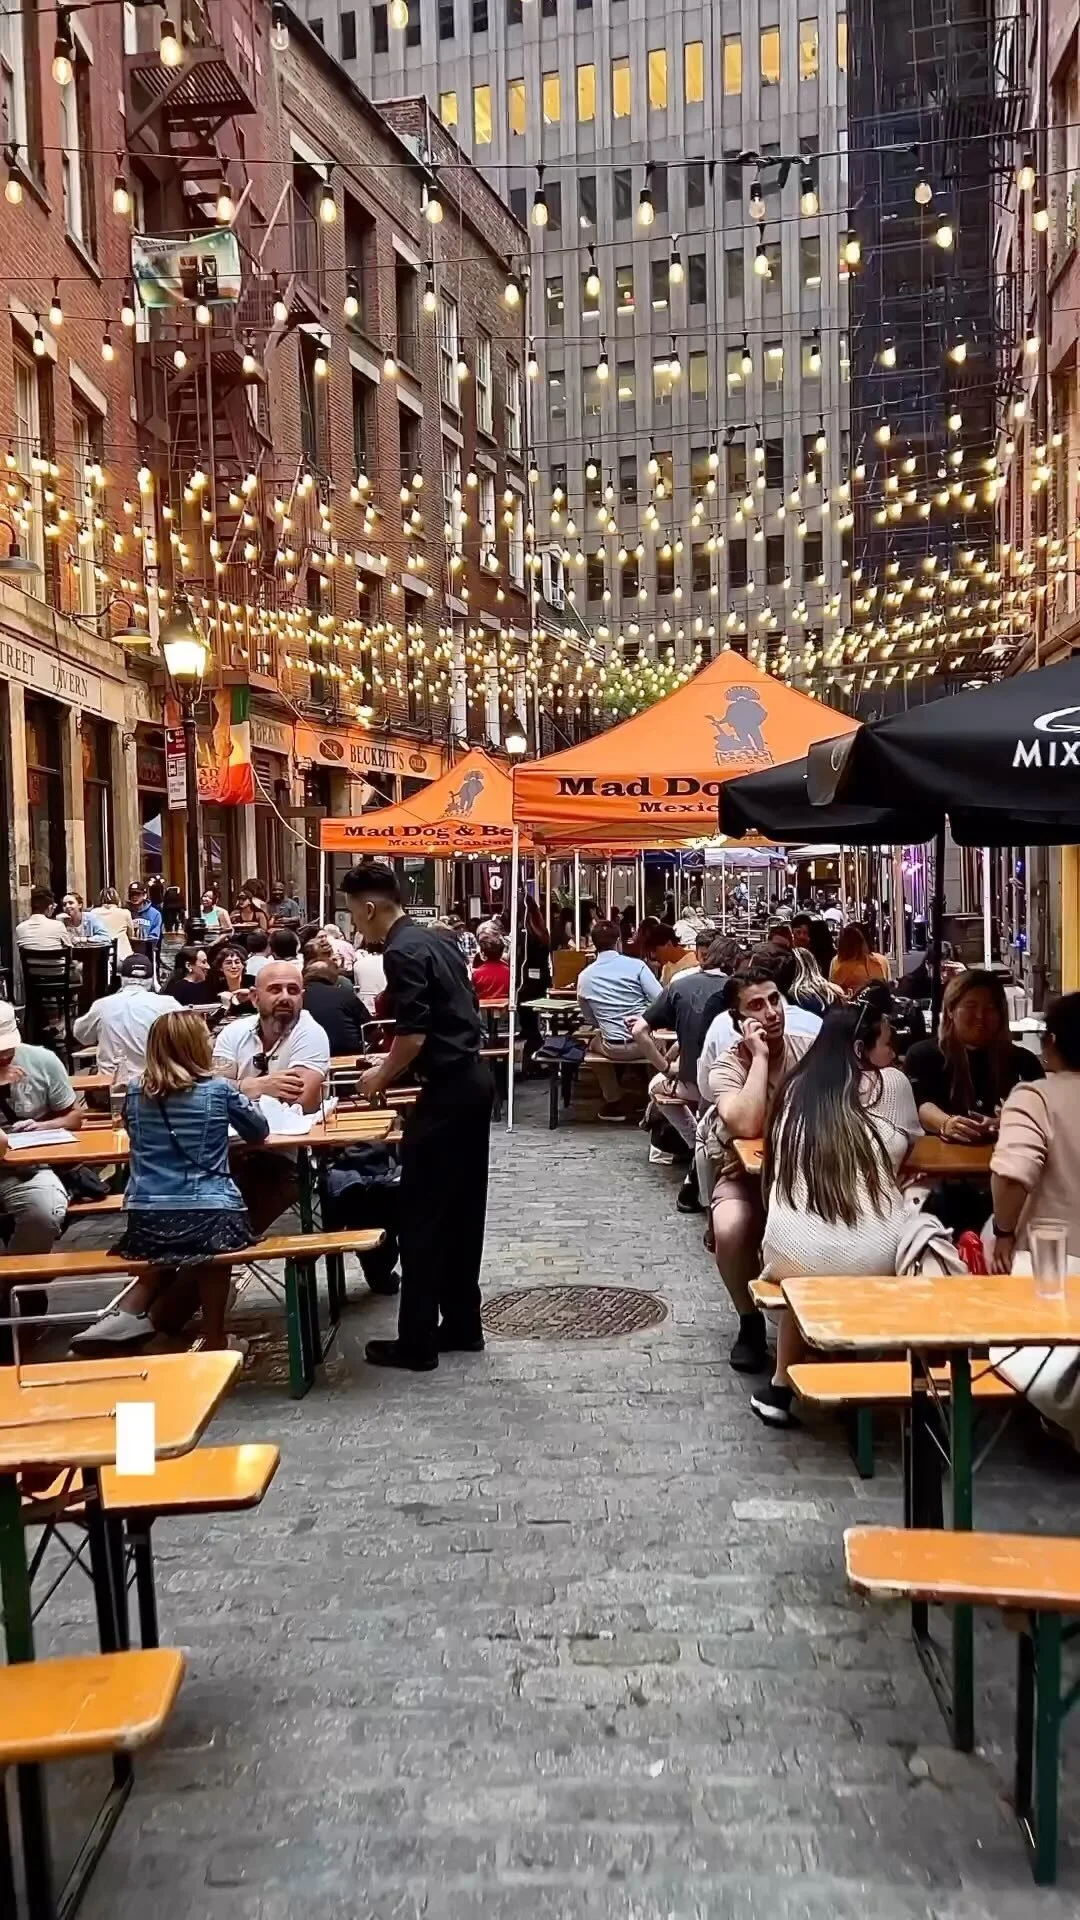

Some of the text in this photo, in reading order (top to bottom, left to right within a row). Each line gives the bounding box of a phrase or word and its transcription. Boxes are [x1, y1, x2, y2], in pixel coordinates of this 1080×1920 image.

[51, 664, 88, 698] TAVERN
[350, 744, 404, 770] BECKETT'S
[556, 776, 653, 797] Mad
[344, 825, 512, 839] Mad Dog & Be
[388, 839, 450, 847] Mexican
